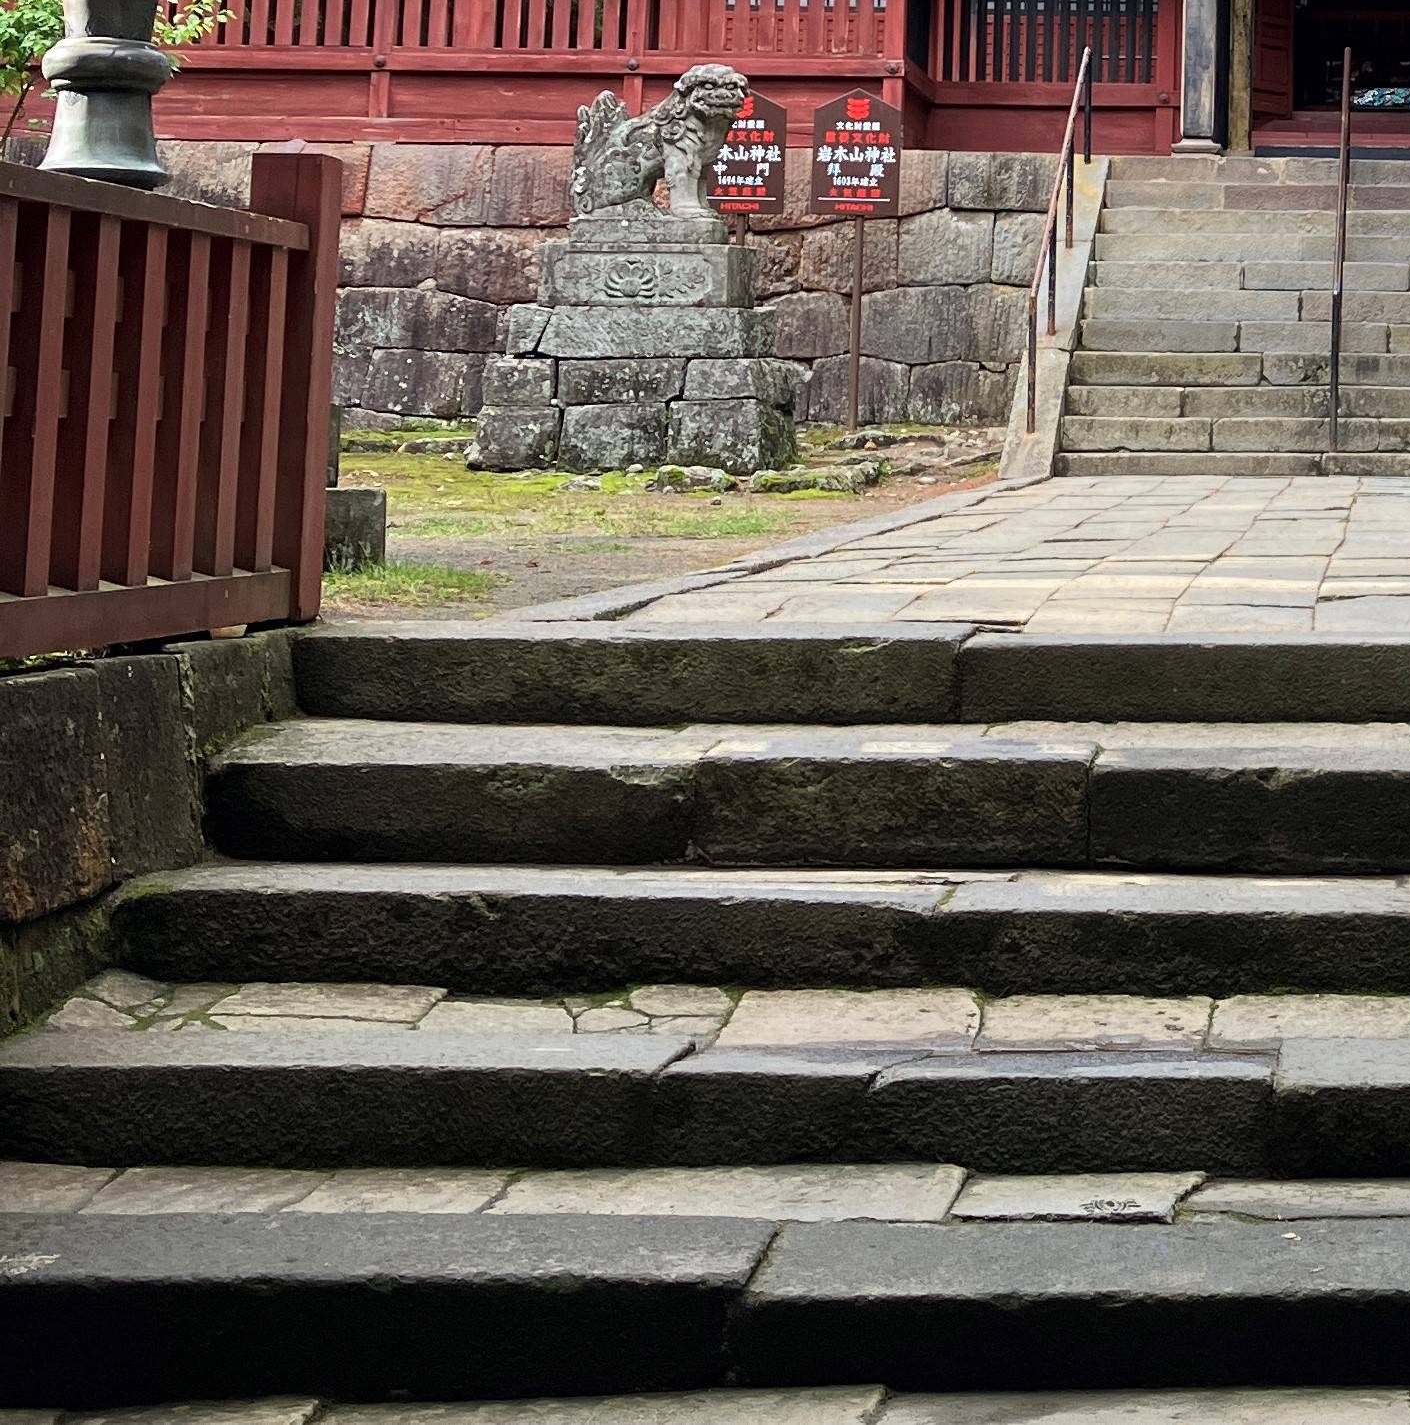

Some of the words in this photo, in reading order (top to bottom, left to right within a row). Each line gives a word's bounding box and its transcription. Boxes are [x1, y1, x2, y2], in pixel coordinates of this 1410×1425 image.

[717, 144, 782, 162] 木山神社
[816, 145, 896, 163] 岩木山神社
[718, 176, 764, 185] 1694年建立
[832, 177, 878, 186] 1603年建立
[834, 203, 874, 211] HITACHI
